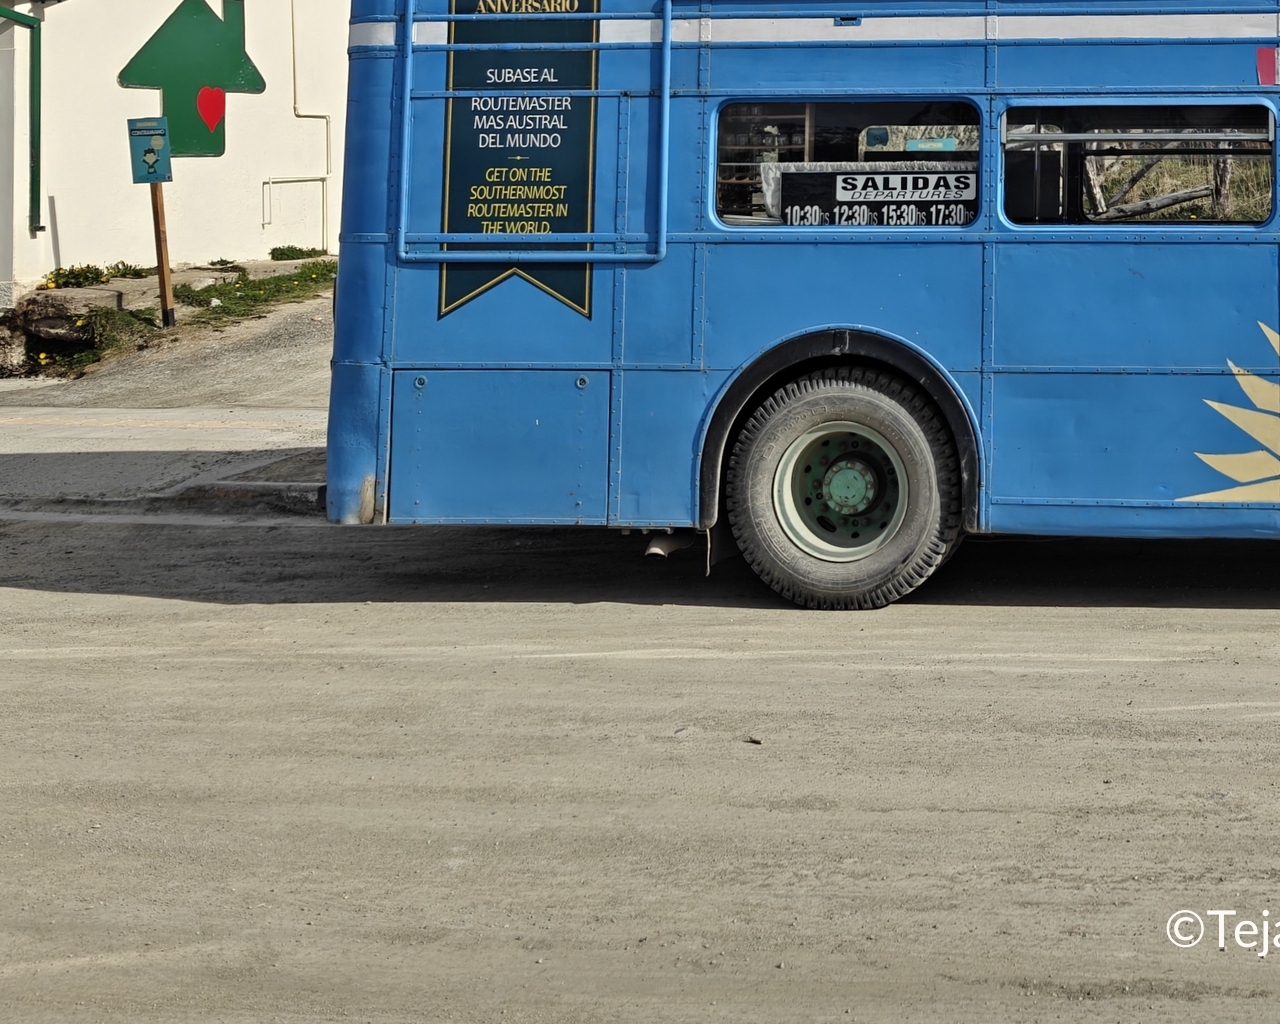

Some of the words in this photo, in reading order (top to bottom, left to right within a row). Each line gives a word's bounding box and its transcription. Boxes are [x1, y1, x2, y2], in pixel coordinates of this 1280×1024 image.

[486, 68, 539, 83] SUBASE
[540, 68, 558, 82] AL
[471, 97, 572, 111] ROUTEMASTER
[473, 115, 504, 129] MAS
[505, 115, 568, 129] AUSTRAL
[479, 133, 504, 148] DEL
[506, 133, 561, 148] MUNDO
[485, 167, 509, 182] GET
[509, 167, 528, 182] ON
[529, 167, 552, 182] THE
[841, 176, 971, 191] SALIDAS
[469, 185, 567, 199] SOUTHERNMOST
[851, 190, 964, 200] DEPARTURES
[467, 203, 554, 217] ROUTEMASTER
[555, 203, 568, 217] IN
[481, 221, 504, 234] THE
